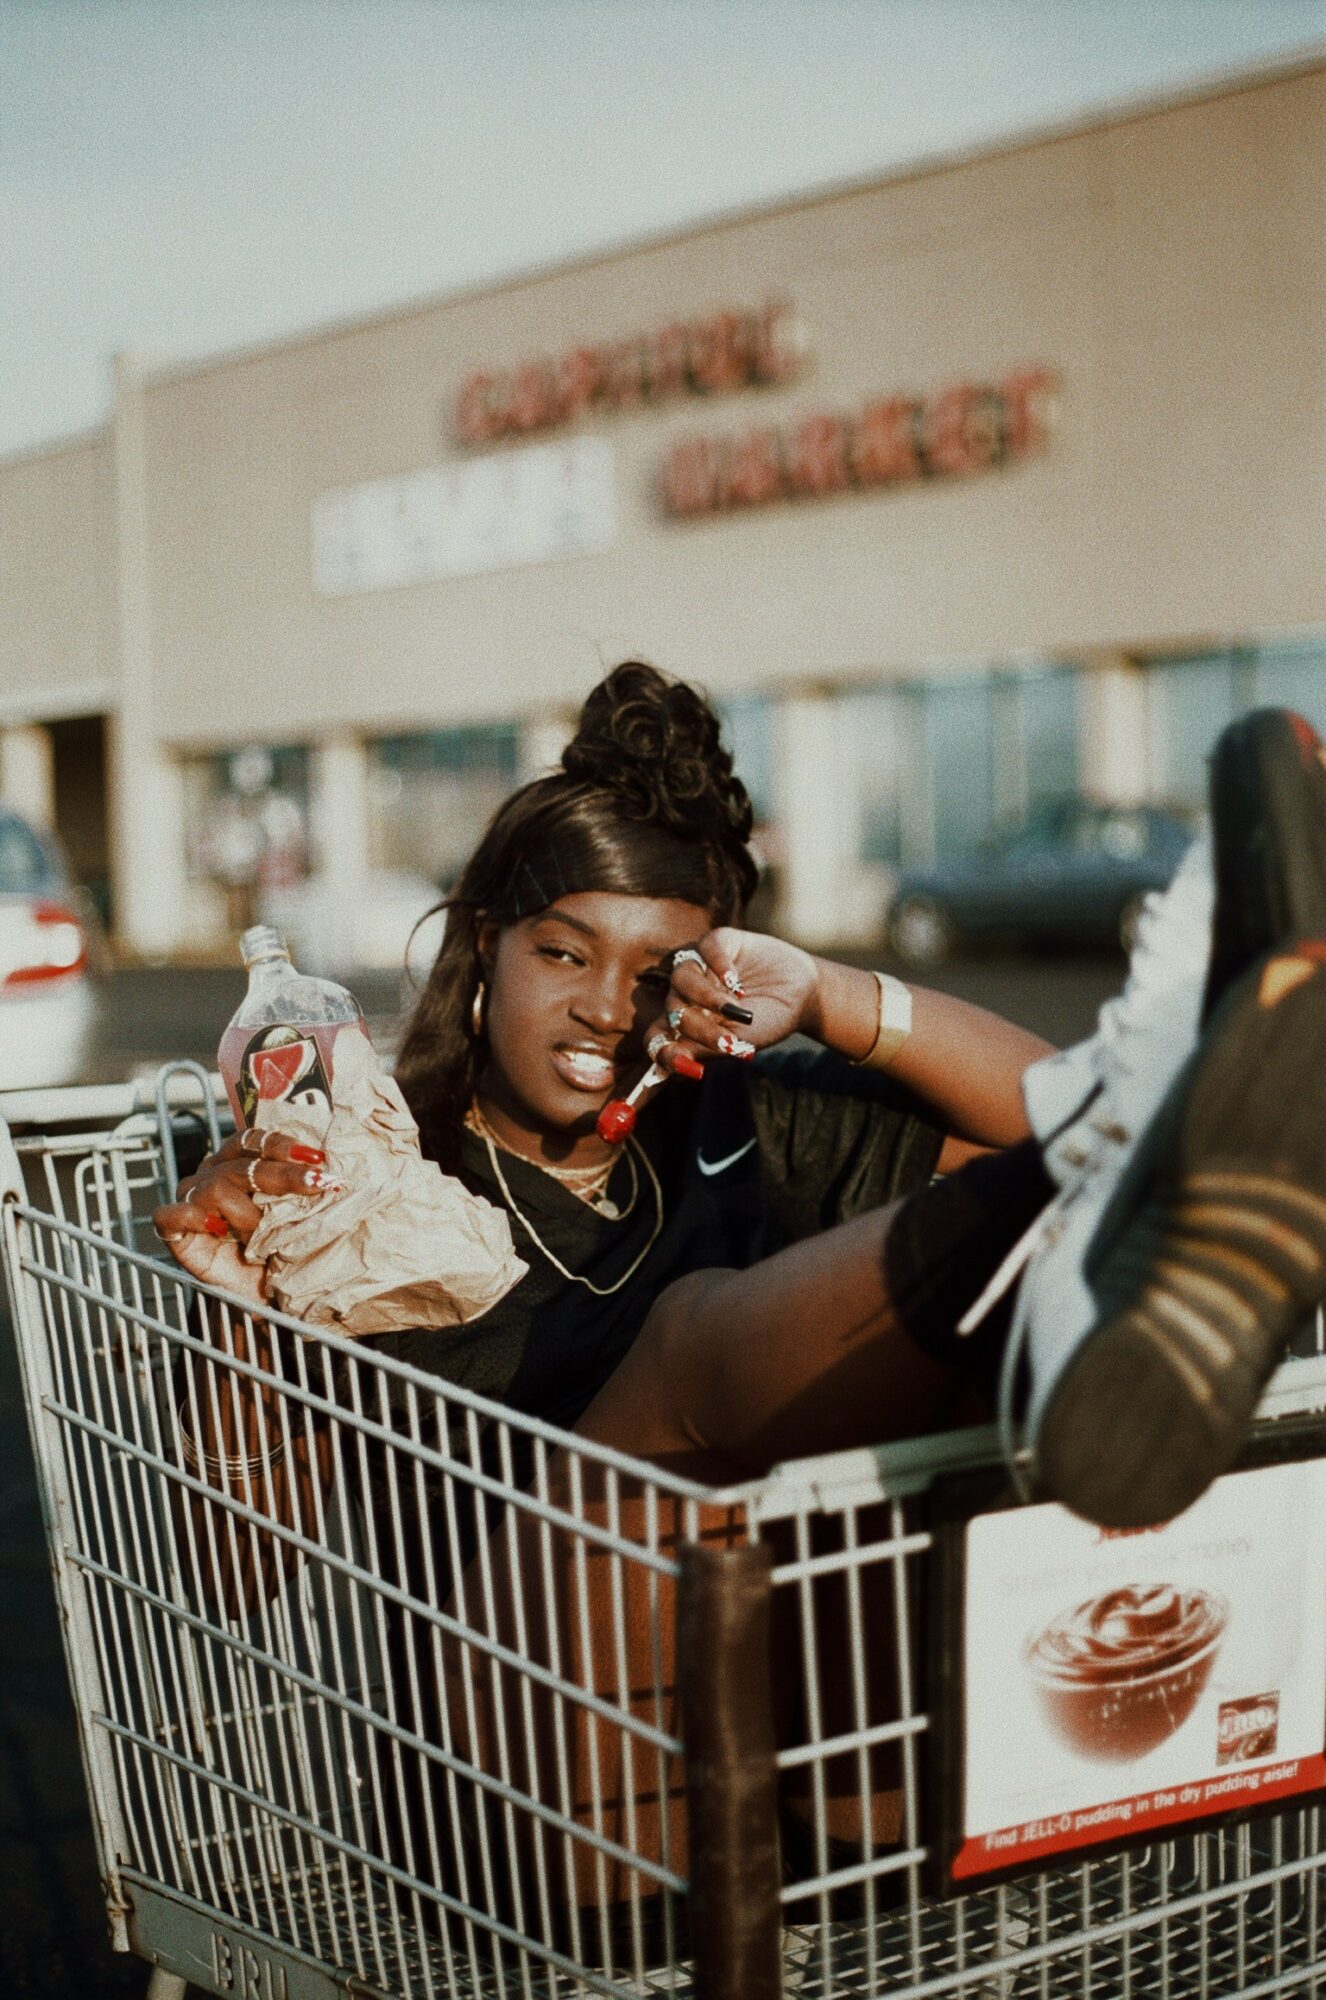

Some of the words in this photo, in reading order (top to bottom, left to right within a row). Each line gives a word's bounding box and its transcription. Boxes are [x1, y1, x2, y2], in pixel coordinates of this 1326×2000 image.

[657, 366, 1058, 516] MARKET
[984, 1831, 1017, 1851] Find
[1023, 1814, 1072, 1842] JELL-O
[1075, 1803, 1132, 1831] pudding
[1136, 1799, 1149, 1813] in
[1154, 1792, 1176, 1809] the
[1180, 1786, 1200, 1803] dry
[1205, 1773, 1260, 1799] pudding
[1263, 1761, 1299, 1784] aisle!
